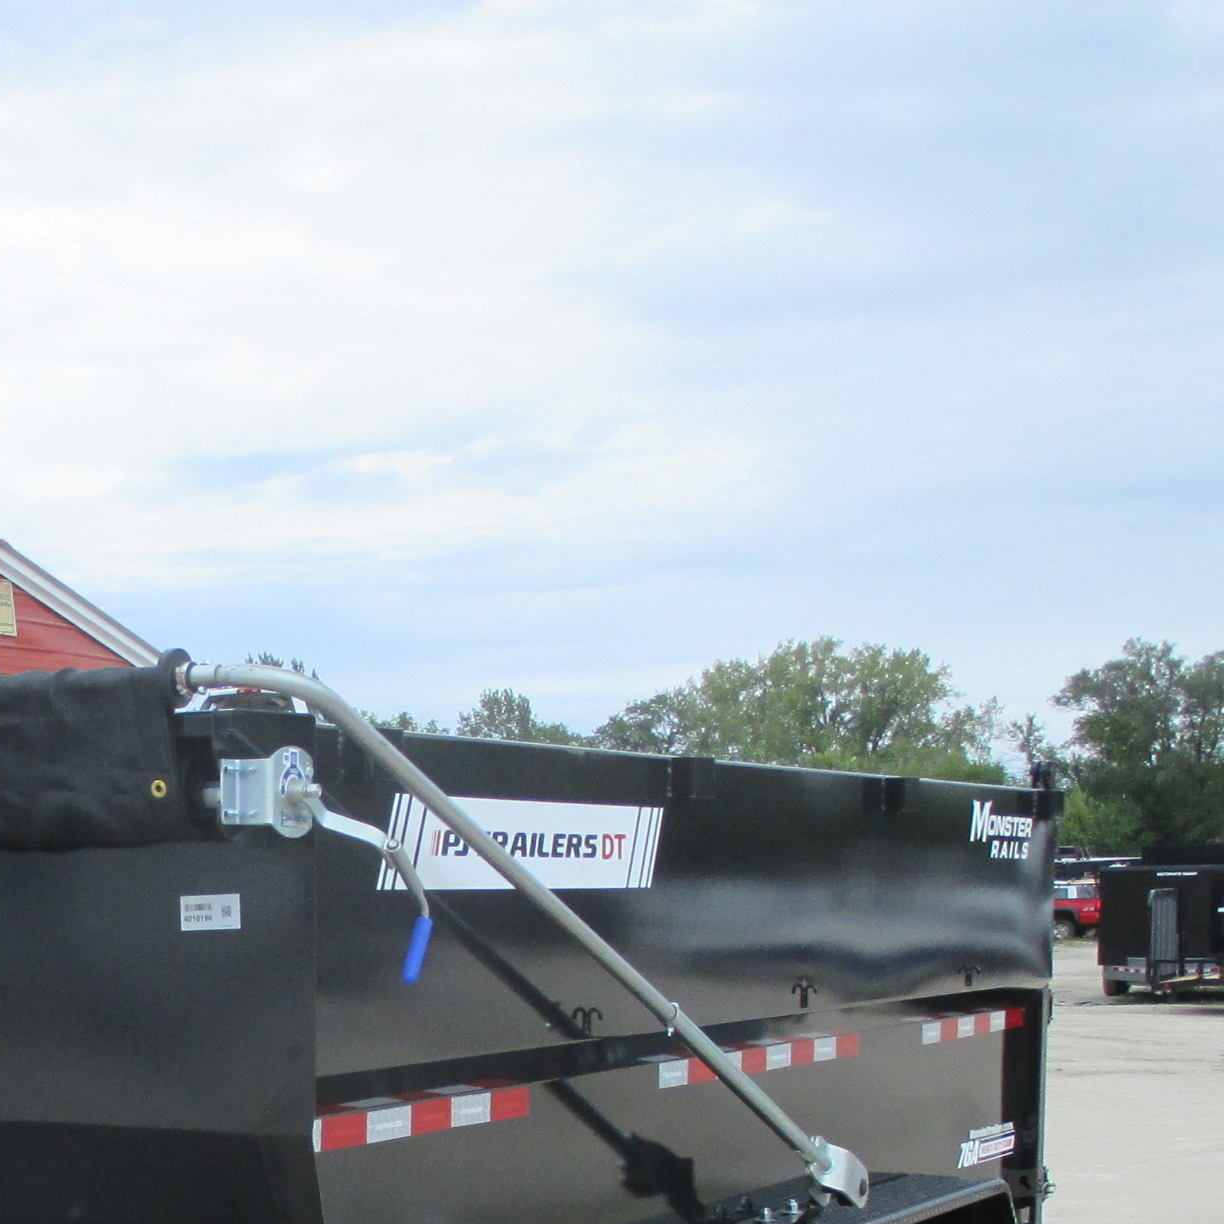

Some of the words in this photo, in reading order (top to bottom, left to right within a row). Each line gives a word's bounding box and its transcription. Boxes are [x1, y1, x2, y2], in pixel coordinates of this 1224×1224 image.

[970, 799, 1033, 842] MONSTER
[476, 831, 598, 859] RAILERS
[990, 840, 1030, 859] RAILS
